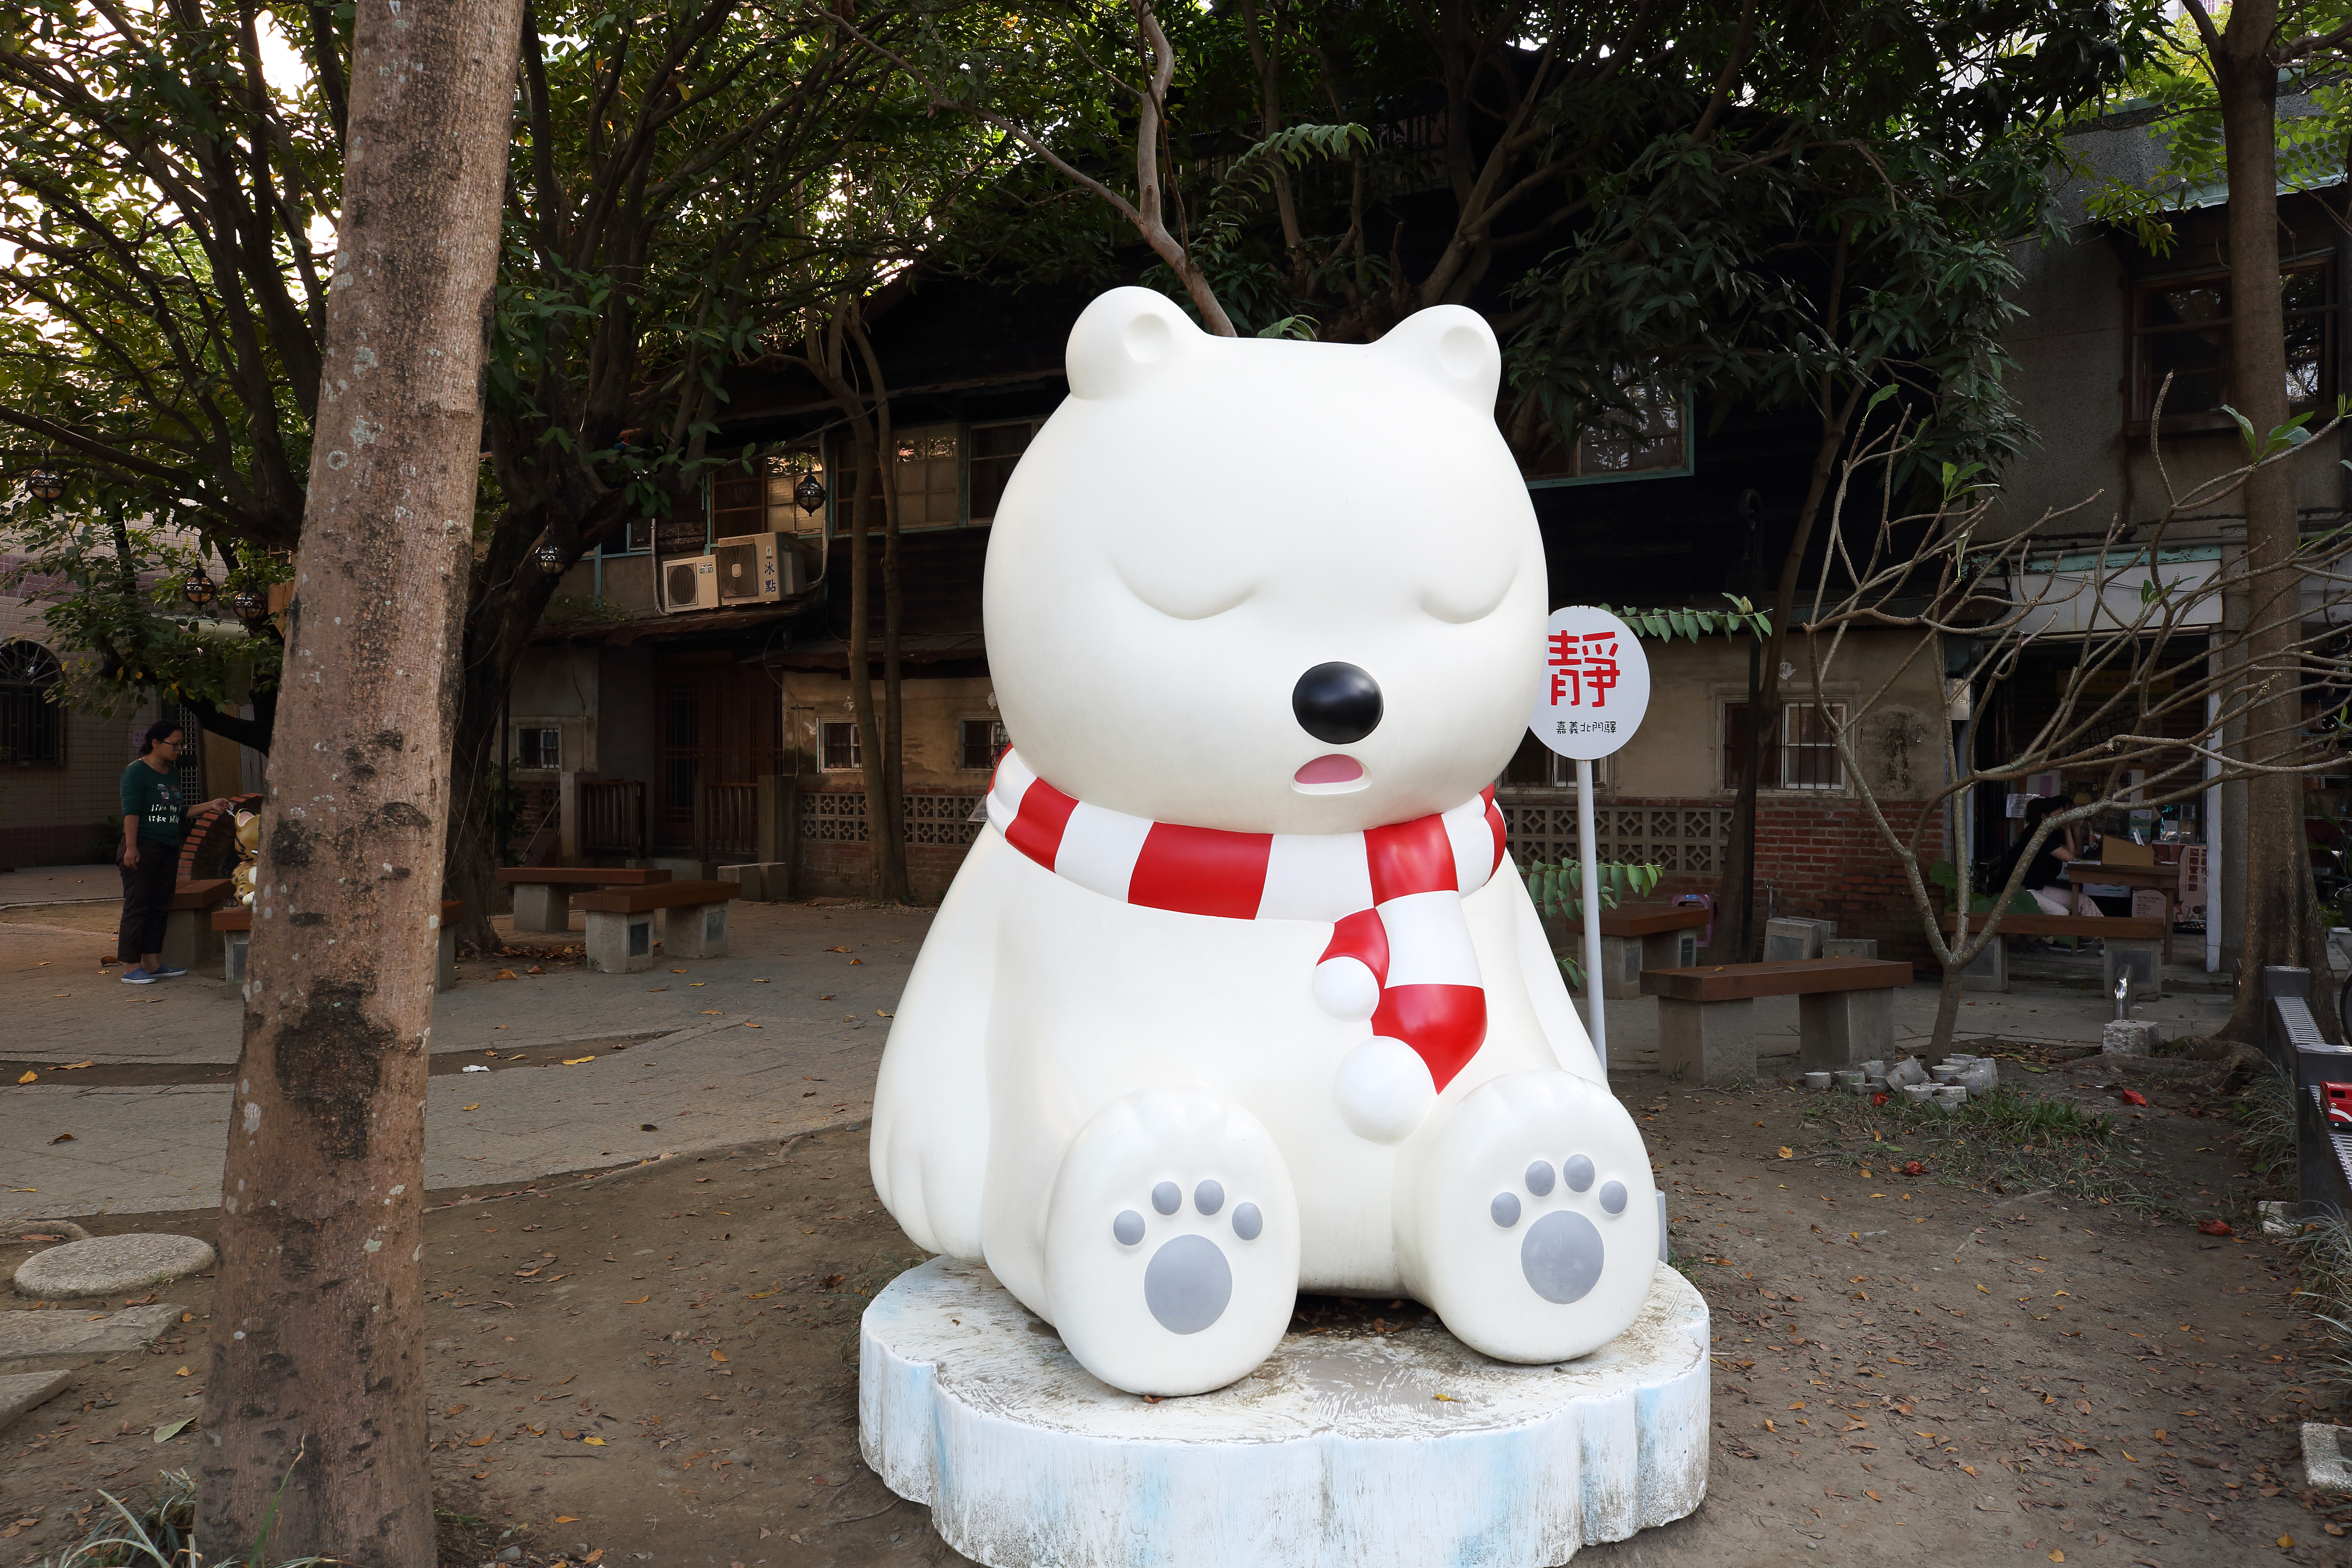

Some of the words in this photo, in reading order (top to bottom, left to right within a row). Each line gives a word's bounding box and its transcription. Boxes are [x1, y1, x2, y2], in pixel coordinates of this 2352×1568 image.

[764, 561, 776, 593] 冰點
[1548, 630, 1620, 707] 靜
[1556, 721, 1617, 734] 嘉義北門驛
[151, 804, 167, 812] like
